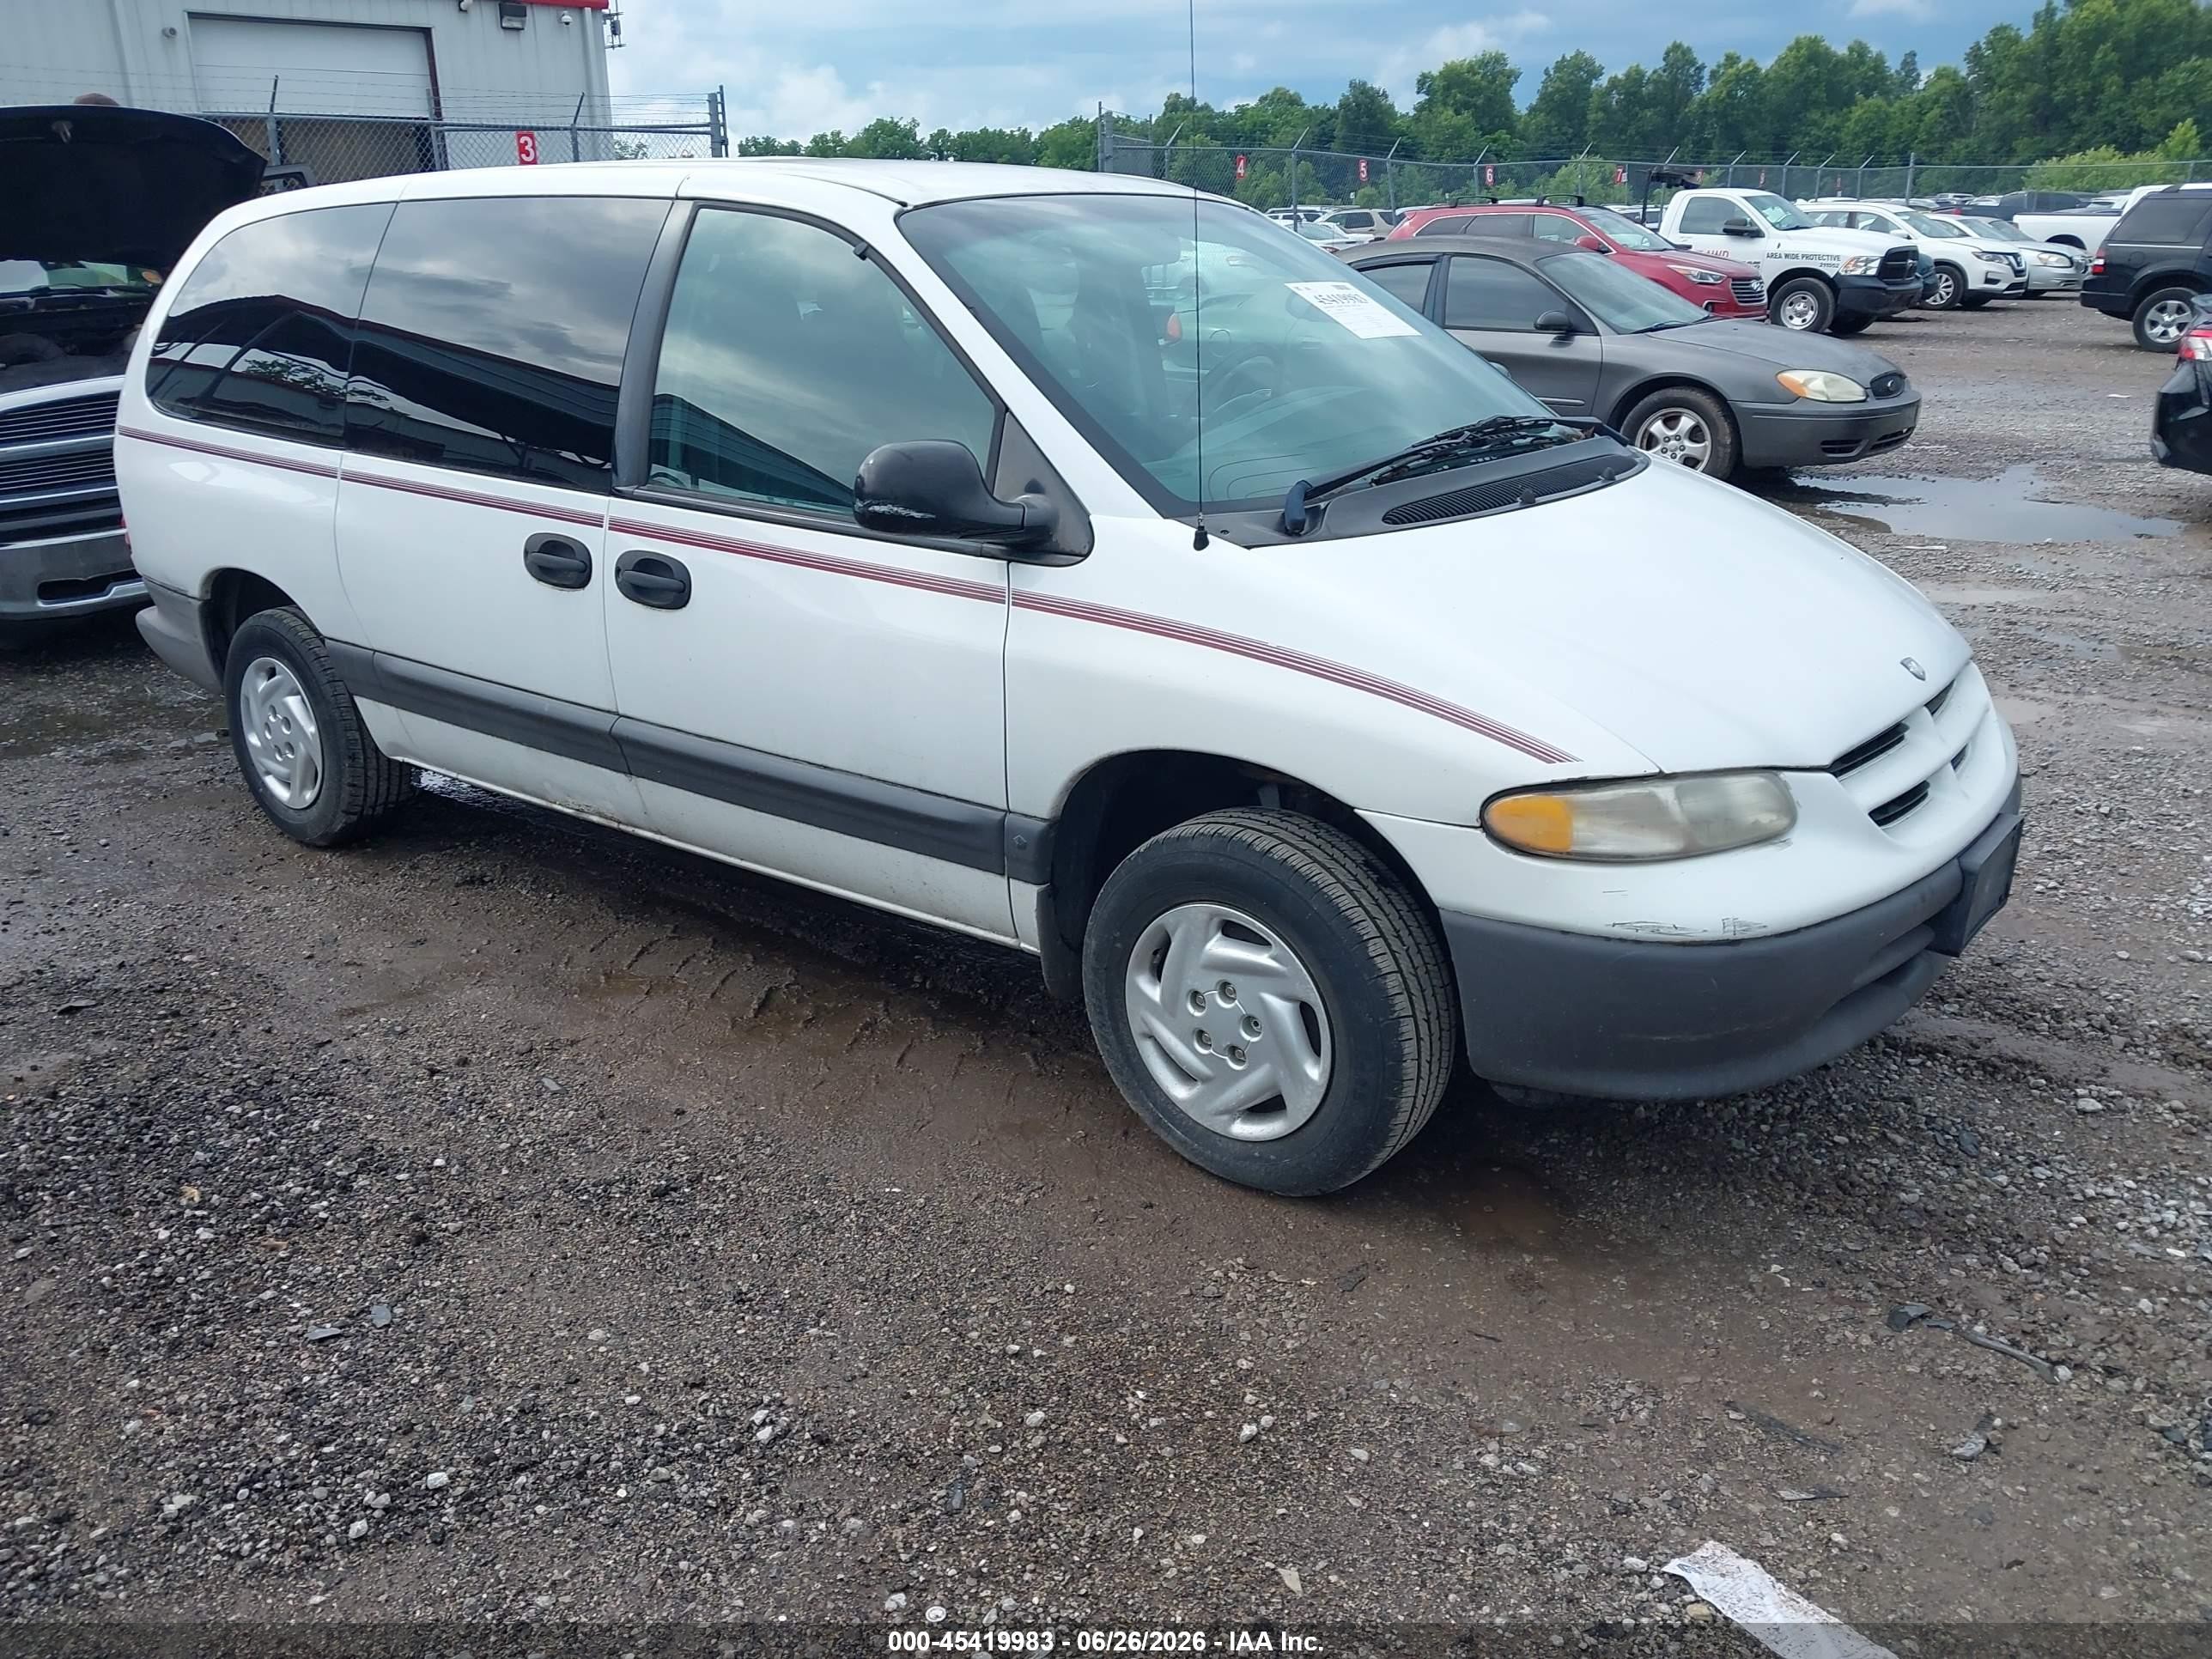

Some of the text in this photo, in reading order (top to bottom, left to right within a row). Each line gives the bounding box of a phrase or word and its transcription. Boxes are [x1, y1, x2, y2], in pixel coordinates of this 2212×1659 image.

[520, 136, 535, 161] 3
[1237, 159, 1244, 176] 4
[1360, 162, 1366, 178] 5
[1486, 168, 1493, 182] 6
[1617, 168, 1623, 181] 7
